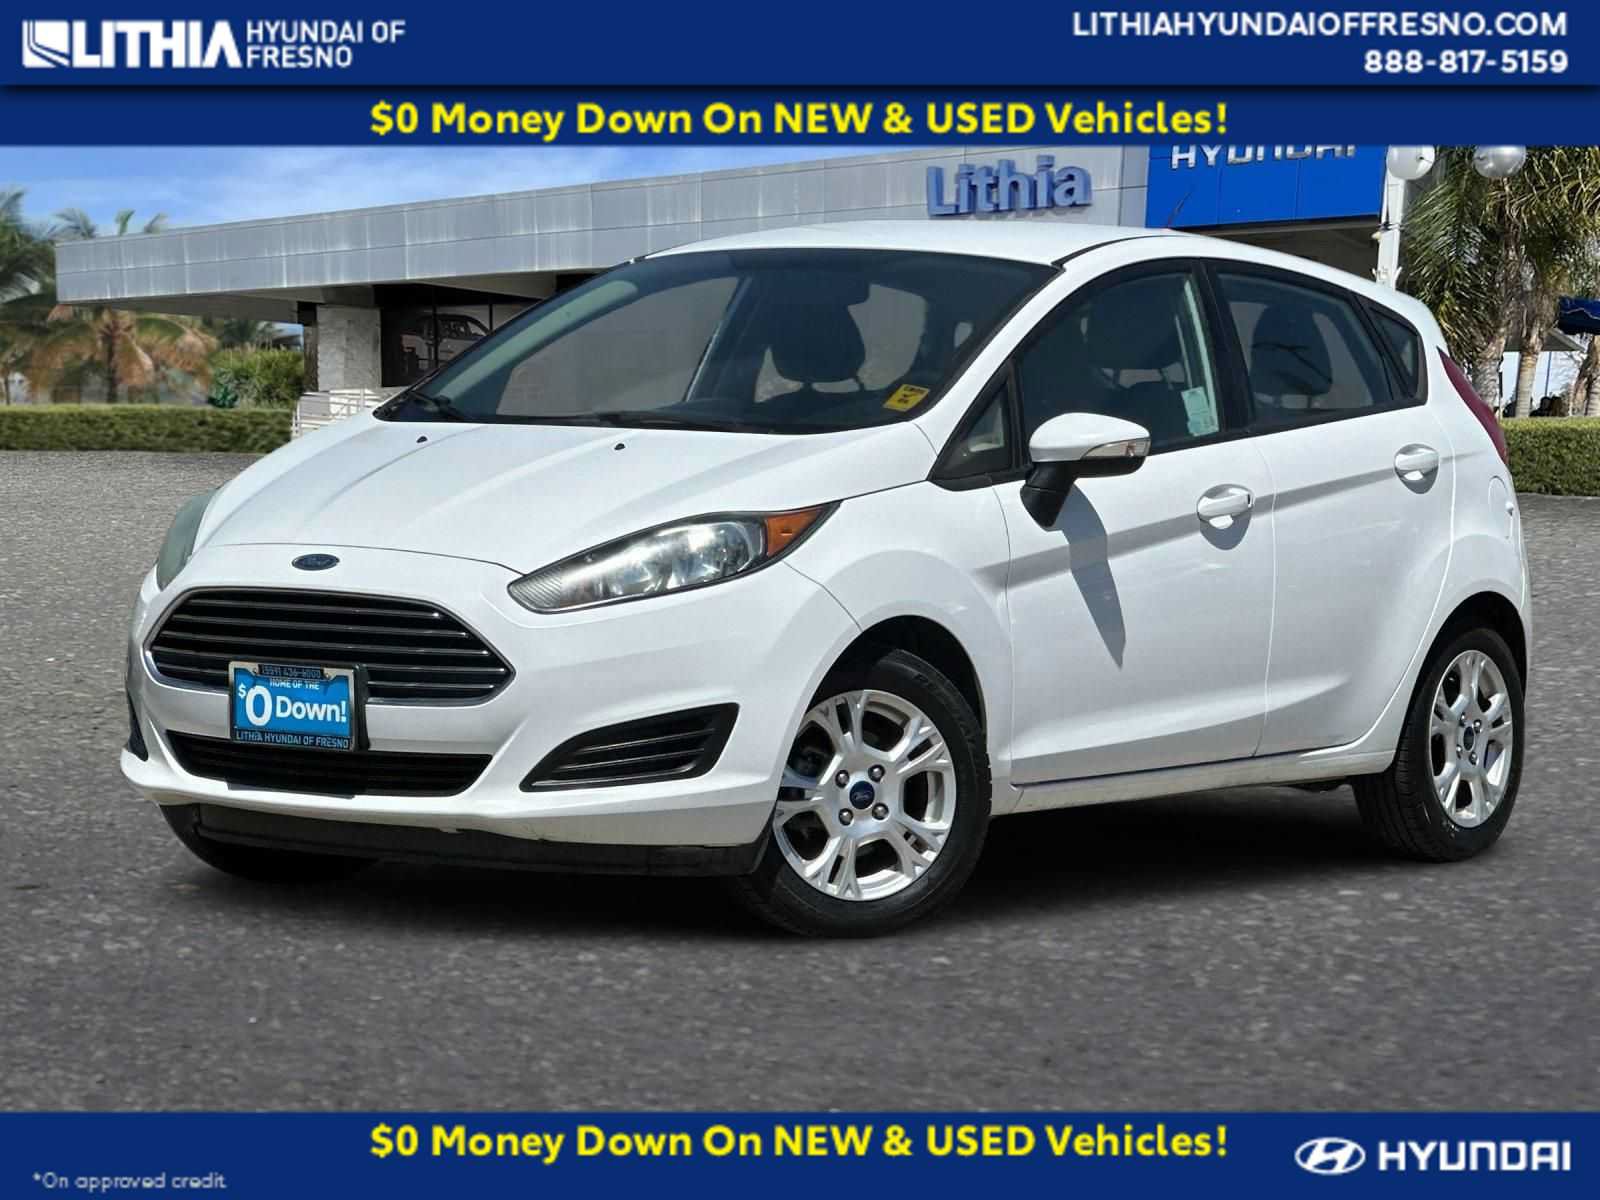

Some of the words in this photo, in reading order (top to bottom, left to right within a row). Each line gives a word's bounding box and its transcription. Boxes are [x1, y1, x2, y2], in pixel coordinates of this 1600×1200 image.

[926, 155, 1092, 216] Lithia
[270, 678, 291, 689] HOME
[292, 680, 303, 689] OF
[276, 695, 347, 723] Down!
[236, 730, 263, 741] LITHIA
[264, 732, 301, 745] HYUNDAI
[303, 735, 315, 746] OF
[316, 736, 349, 749] FRESNO
